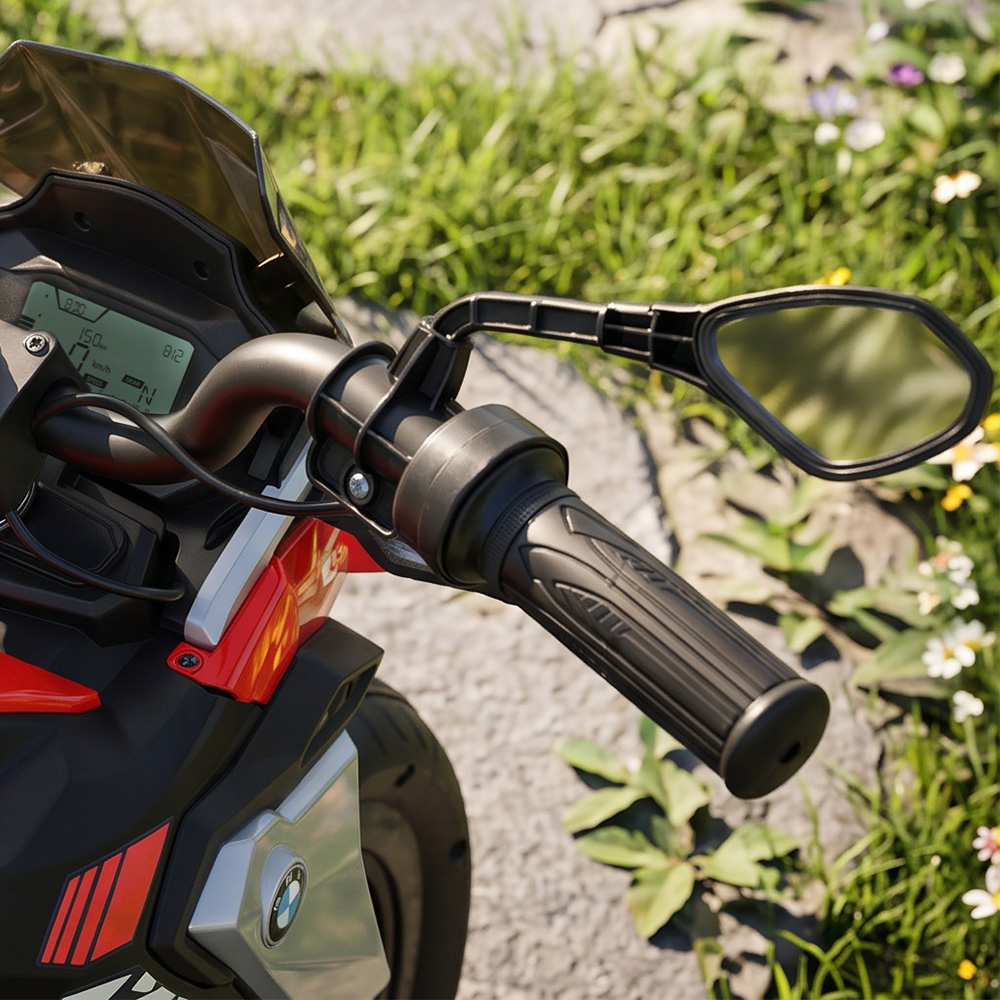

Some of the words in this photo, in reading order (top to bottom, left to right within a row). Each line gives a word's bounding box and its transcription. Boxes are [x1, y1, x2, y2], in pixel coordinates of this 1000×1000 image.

[79, 327, 102, 347] 150
[92, 359, 111, 374] km/h
[138, 385, 157, 406] N
